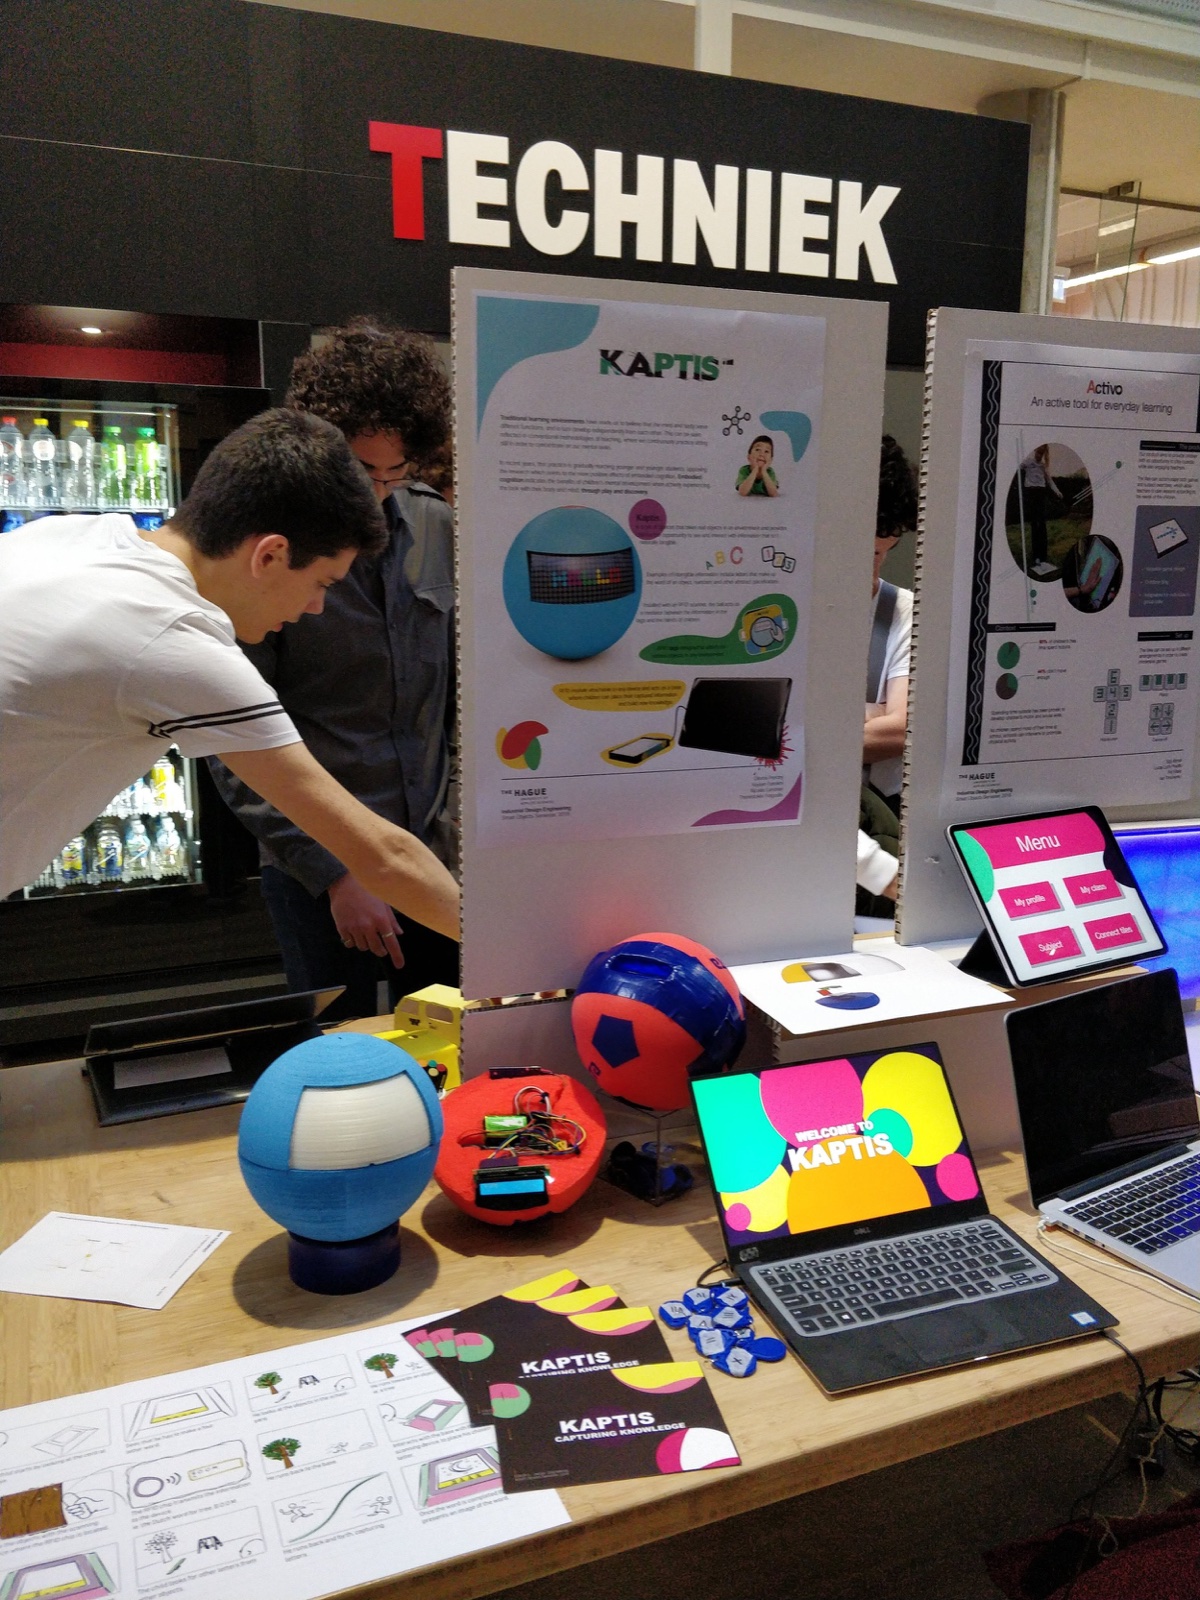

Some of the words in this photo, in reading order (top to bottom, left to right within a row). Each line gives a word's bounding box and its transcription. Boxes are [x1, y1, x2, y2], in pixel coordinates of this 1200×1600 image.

[368, 120, 902, 285] TECHNIEK
[599, 348, 720, 381] KAPTIS
[1086, 379, 1123, 396] Activo
[1031, 396, 1044, 407] An
[1045, 398, 1071, 408] active
[1073, 398, 1089, 409] tool
[1090, 399, 1102, 410] for
[1104, 401, 1139, 414] everyday
[1142, 402, 1173, 415] learning
[715, 550, 725, 565] B
[730, 546, 743, 565] C
[969, 772, 996, 780] HAGUE
[514, 787, 547, 796] HAGUE
[1015, 834, 1061, 853] Menu
[1080, 885, 1090, 895] My
[1090, 882, 1107, 892] class
[1014, 898, 1026, 908] My
[1025, 894, 1046, 907] profile
[1095, 929, 1119, 941] Connect
[1038, 939, 1064, 954] Subject
[795, 1122, 857, 1143] WELCOME
[857, 1119, 874, 1132] TO
[787, 1132, 894, 1171] KAPTIS
[521, 1351, 611, 1374] KAPTIS
[578, 1359, 640, 1373] KNOWLEDGE
[559, 1411, 656, 1433] KAPTIS
[554, 1429, 618, 1444] CAPTURING
[619, 1421, 686, 1438] KNOWLEDGE
